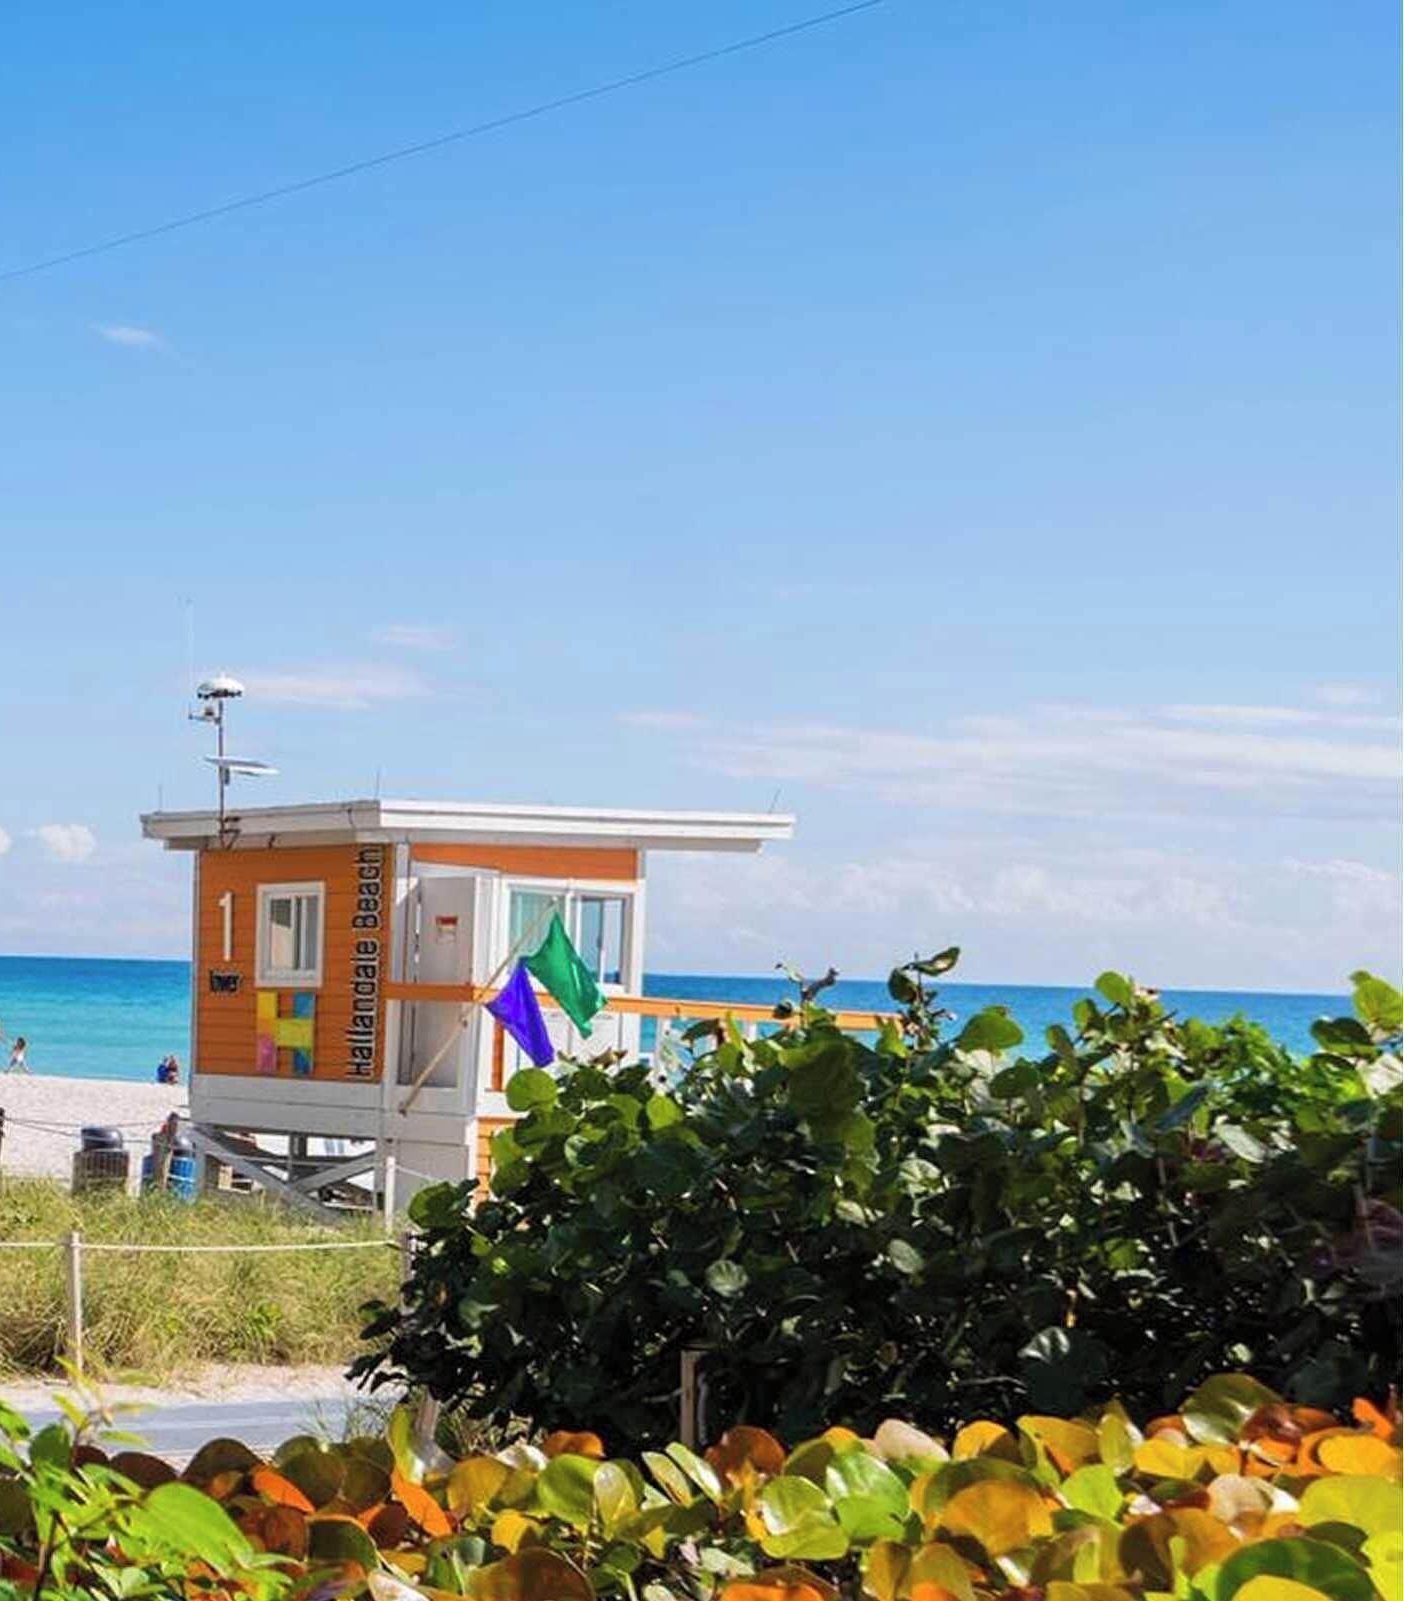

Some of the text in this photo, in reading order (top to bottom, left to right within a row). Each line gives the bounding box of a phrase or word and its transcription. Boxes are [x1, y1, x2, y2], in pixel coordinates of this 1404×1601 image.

[218, 891, 233, 962] 1
[346, 847, 381, 1077] Hallandale Beach
